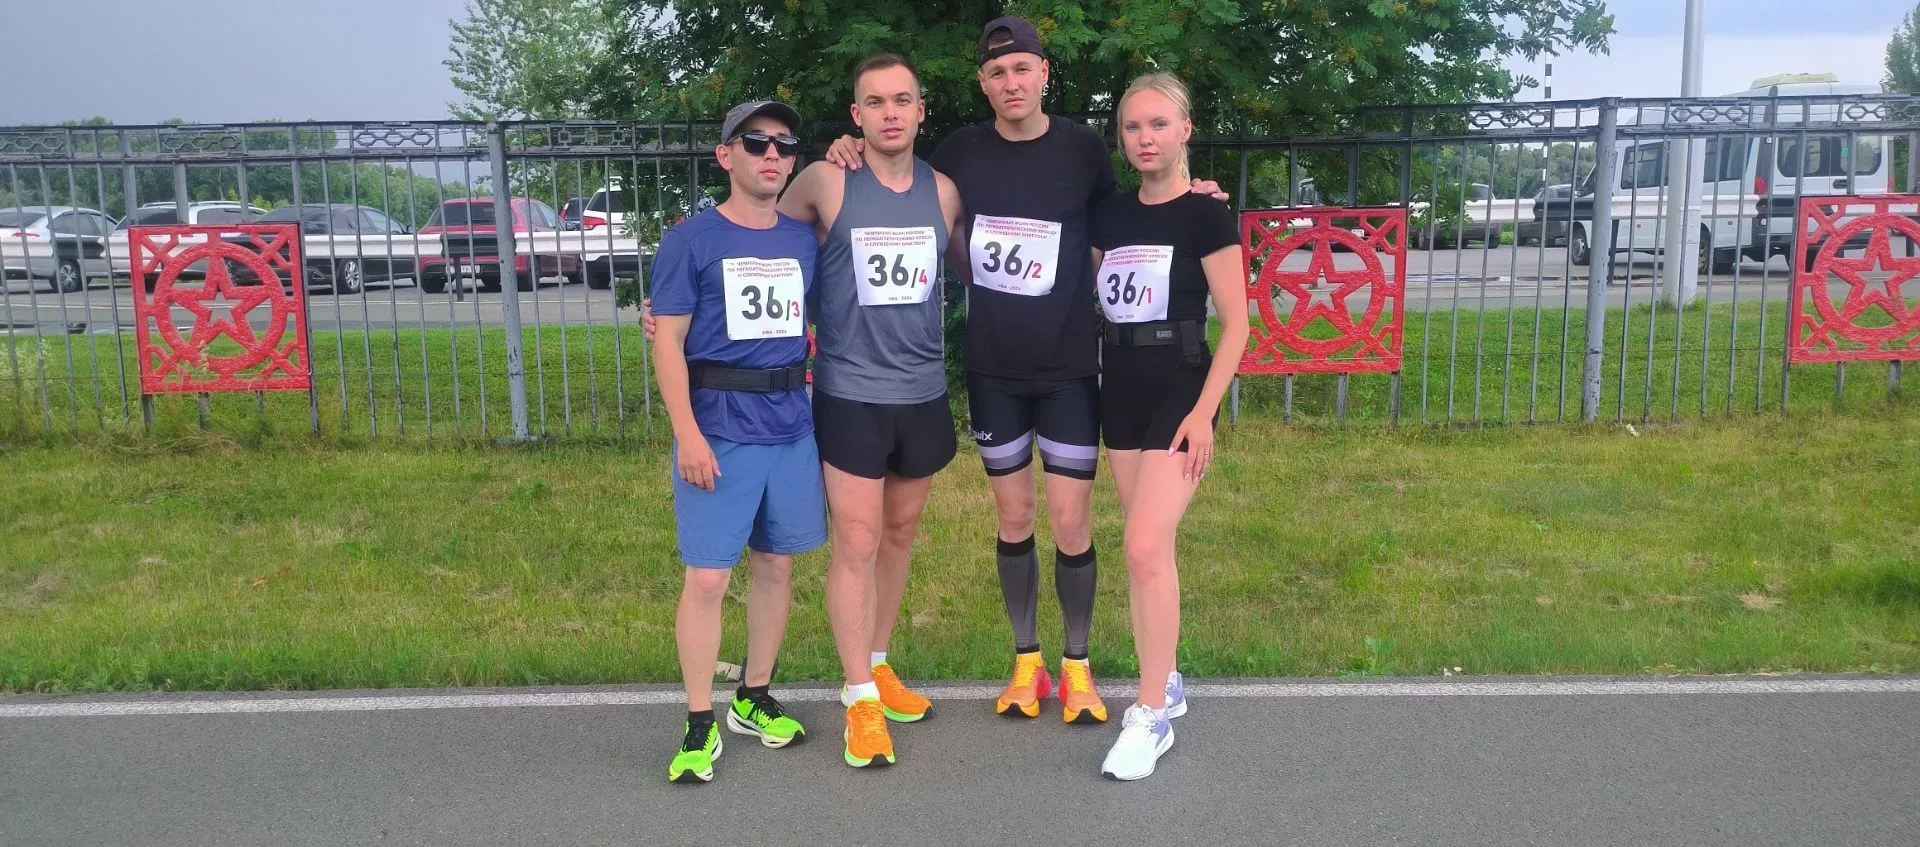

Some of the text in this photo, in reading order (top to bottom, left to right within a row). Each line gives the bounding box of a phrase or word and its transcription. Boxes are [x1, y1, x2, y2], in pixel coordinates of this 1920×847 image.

[868, 254, 928, 288] 36/4
[982, 241, 1042, 280] 36/2
[741, 285, 800, 321] 36/3
[1107, 272, 1152, 306] 36/1
